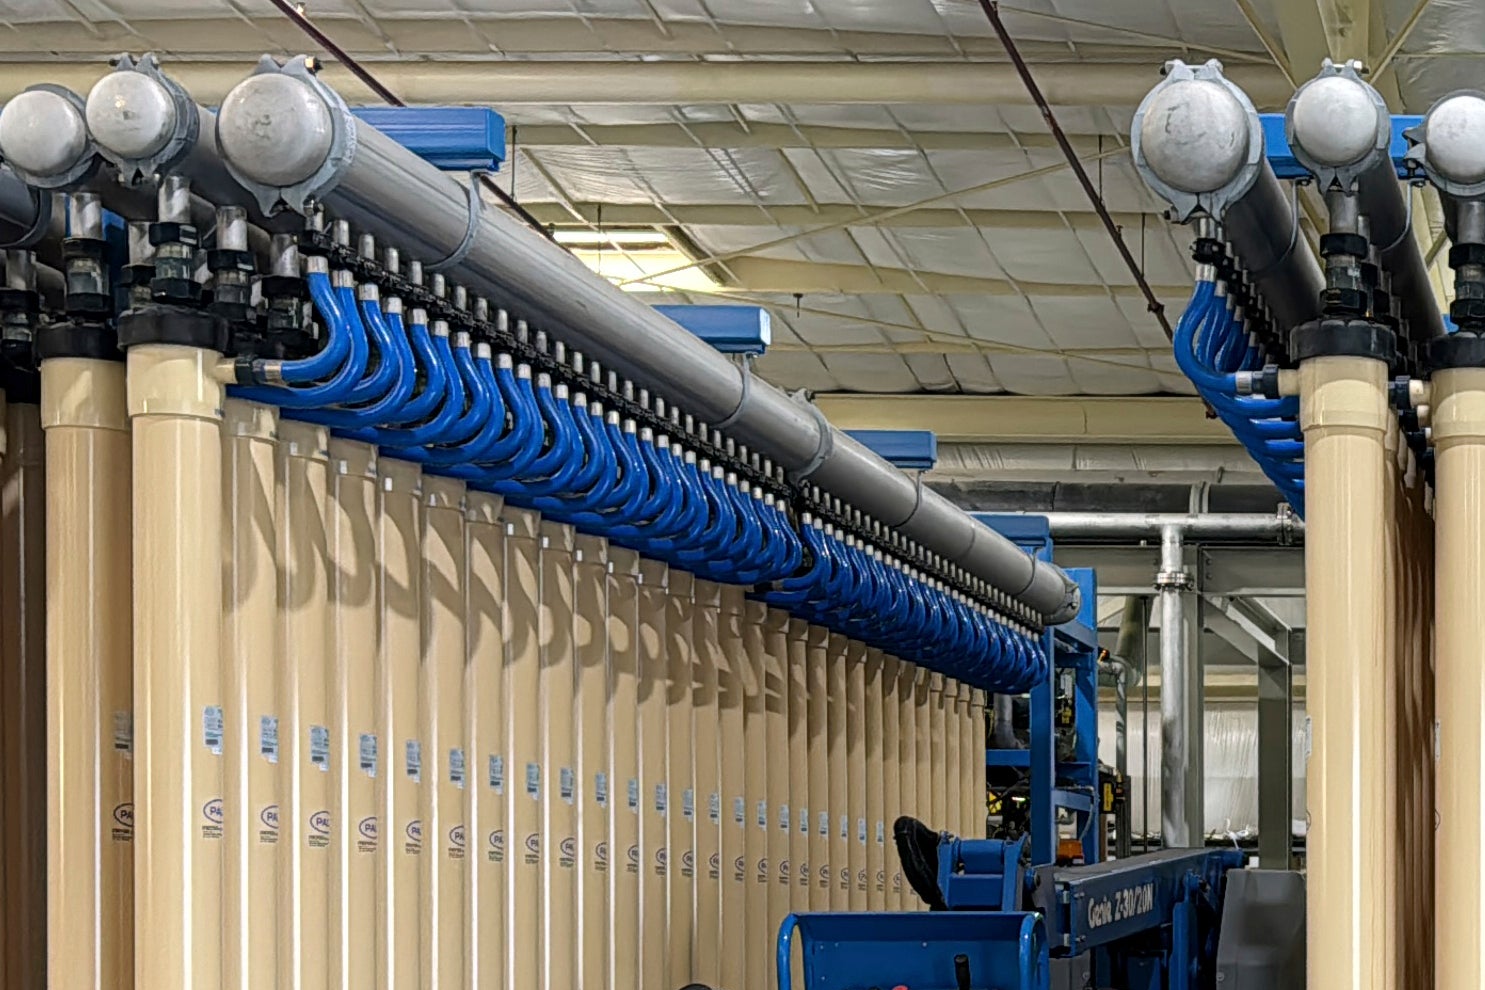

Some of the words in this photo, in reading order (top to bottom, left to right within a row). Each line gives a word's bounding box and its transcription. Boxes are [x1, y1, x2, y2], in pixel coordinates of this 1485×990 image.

[120, 810, 134, 820] PA
[210, 806, 223, 816] PA
[267, 812, 278, 822] PA
[1088, 897, 1112, 928] Genie
[1115, 883, 1154, 921] Z-30/20N
